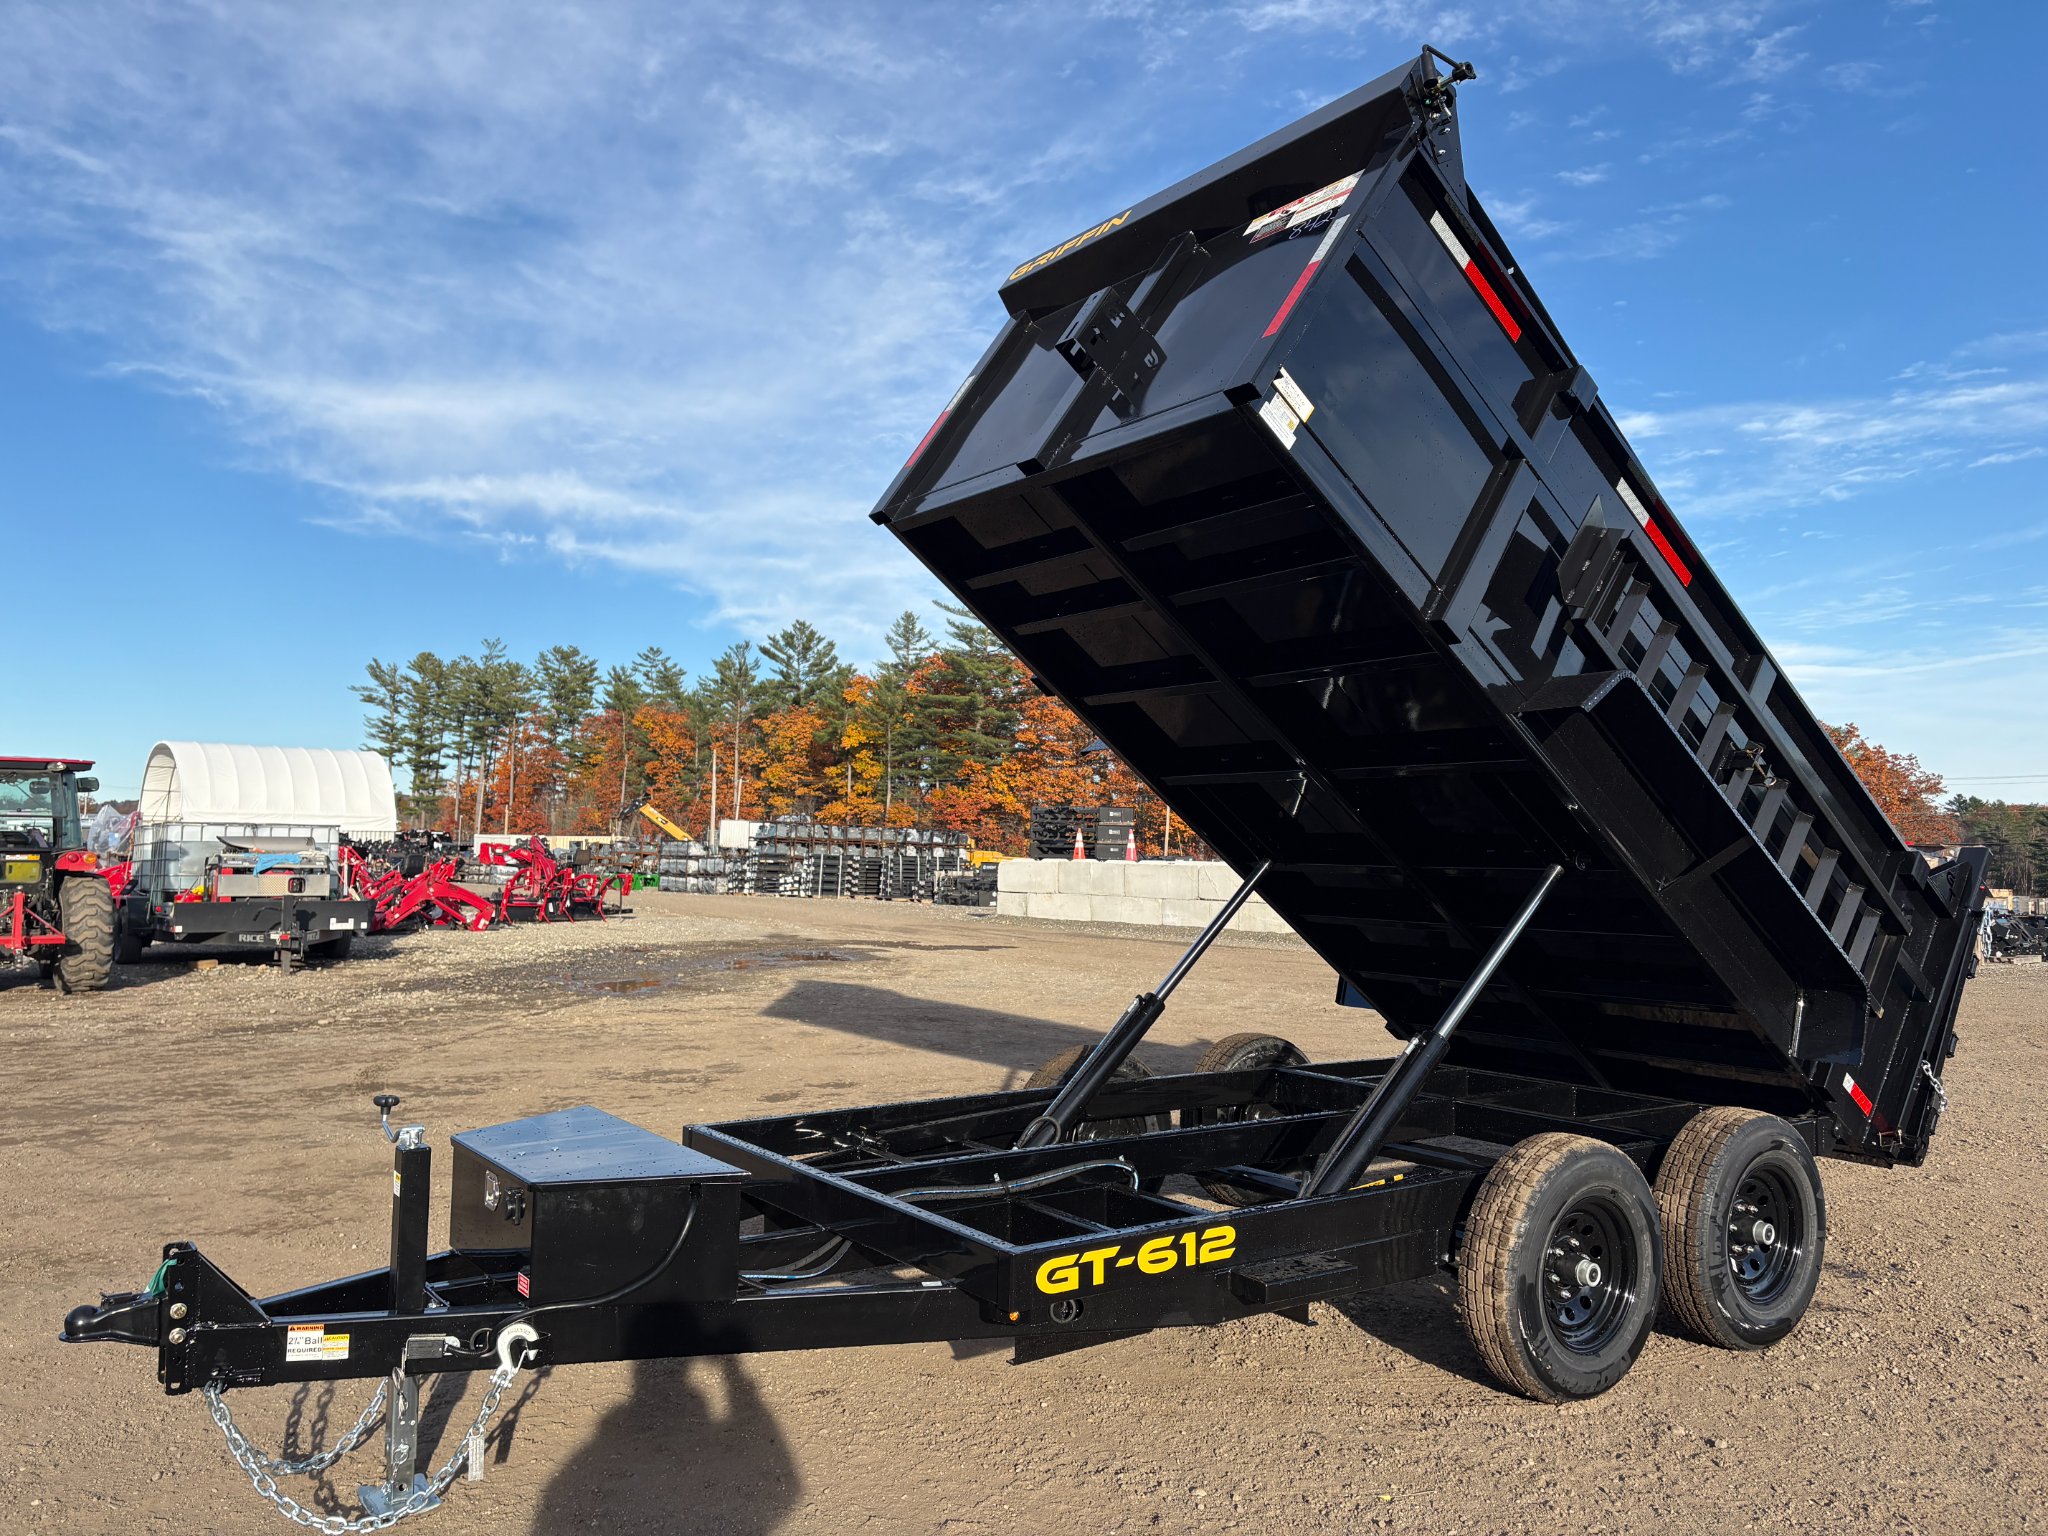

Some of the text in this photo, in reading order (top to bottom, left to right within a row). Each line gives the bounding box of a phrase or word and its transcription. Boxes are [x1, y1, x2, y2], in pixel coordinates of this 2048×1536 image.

[1009, 209, 1132, 280] GRIFFIN
[238, 933, 264, 943] RICE
[1035, 1225, 1236, 1295] GT-612
[304, 1336, 323, 1345] Ball
